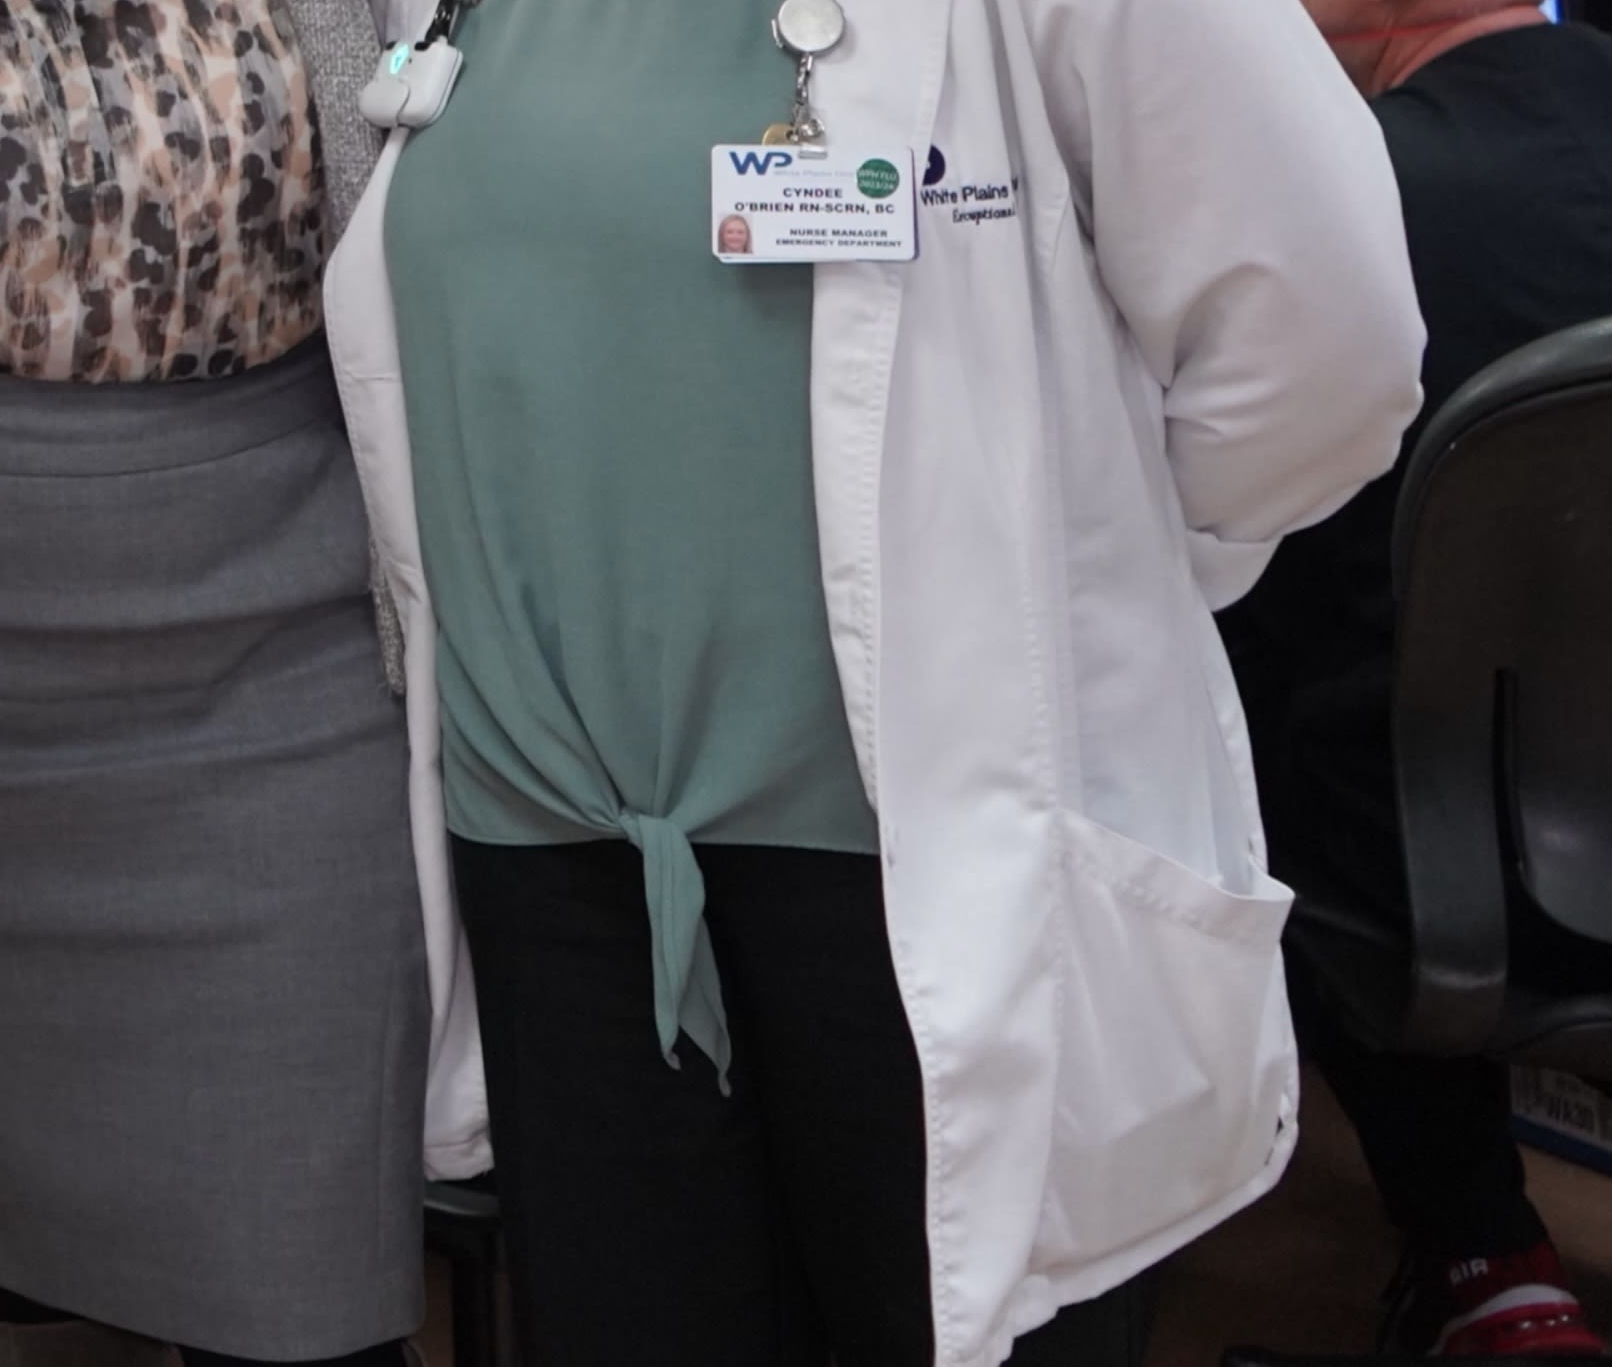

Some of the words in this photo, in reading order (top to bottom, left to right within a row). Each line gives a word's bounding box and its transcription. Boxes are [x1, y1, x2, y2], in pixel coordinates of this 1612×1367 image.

[729, 151, 793, 176] WP
[783, 188, 843, 199] CYNDEE
[920, 189, 958, 207] White
[962, 184, 1009, 202] Plains
[734, 201, 794, 214] O'BRIEN
[875, 203, 896, 214] BC
[789, 229, 827, 237] NURSE
[831, 229, 888, 238] MANAGER
[776, 238, 834, 246] EMERGENCY
[837, 238, 902, 248] DEPARTMENT
